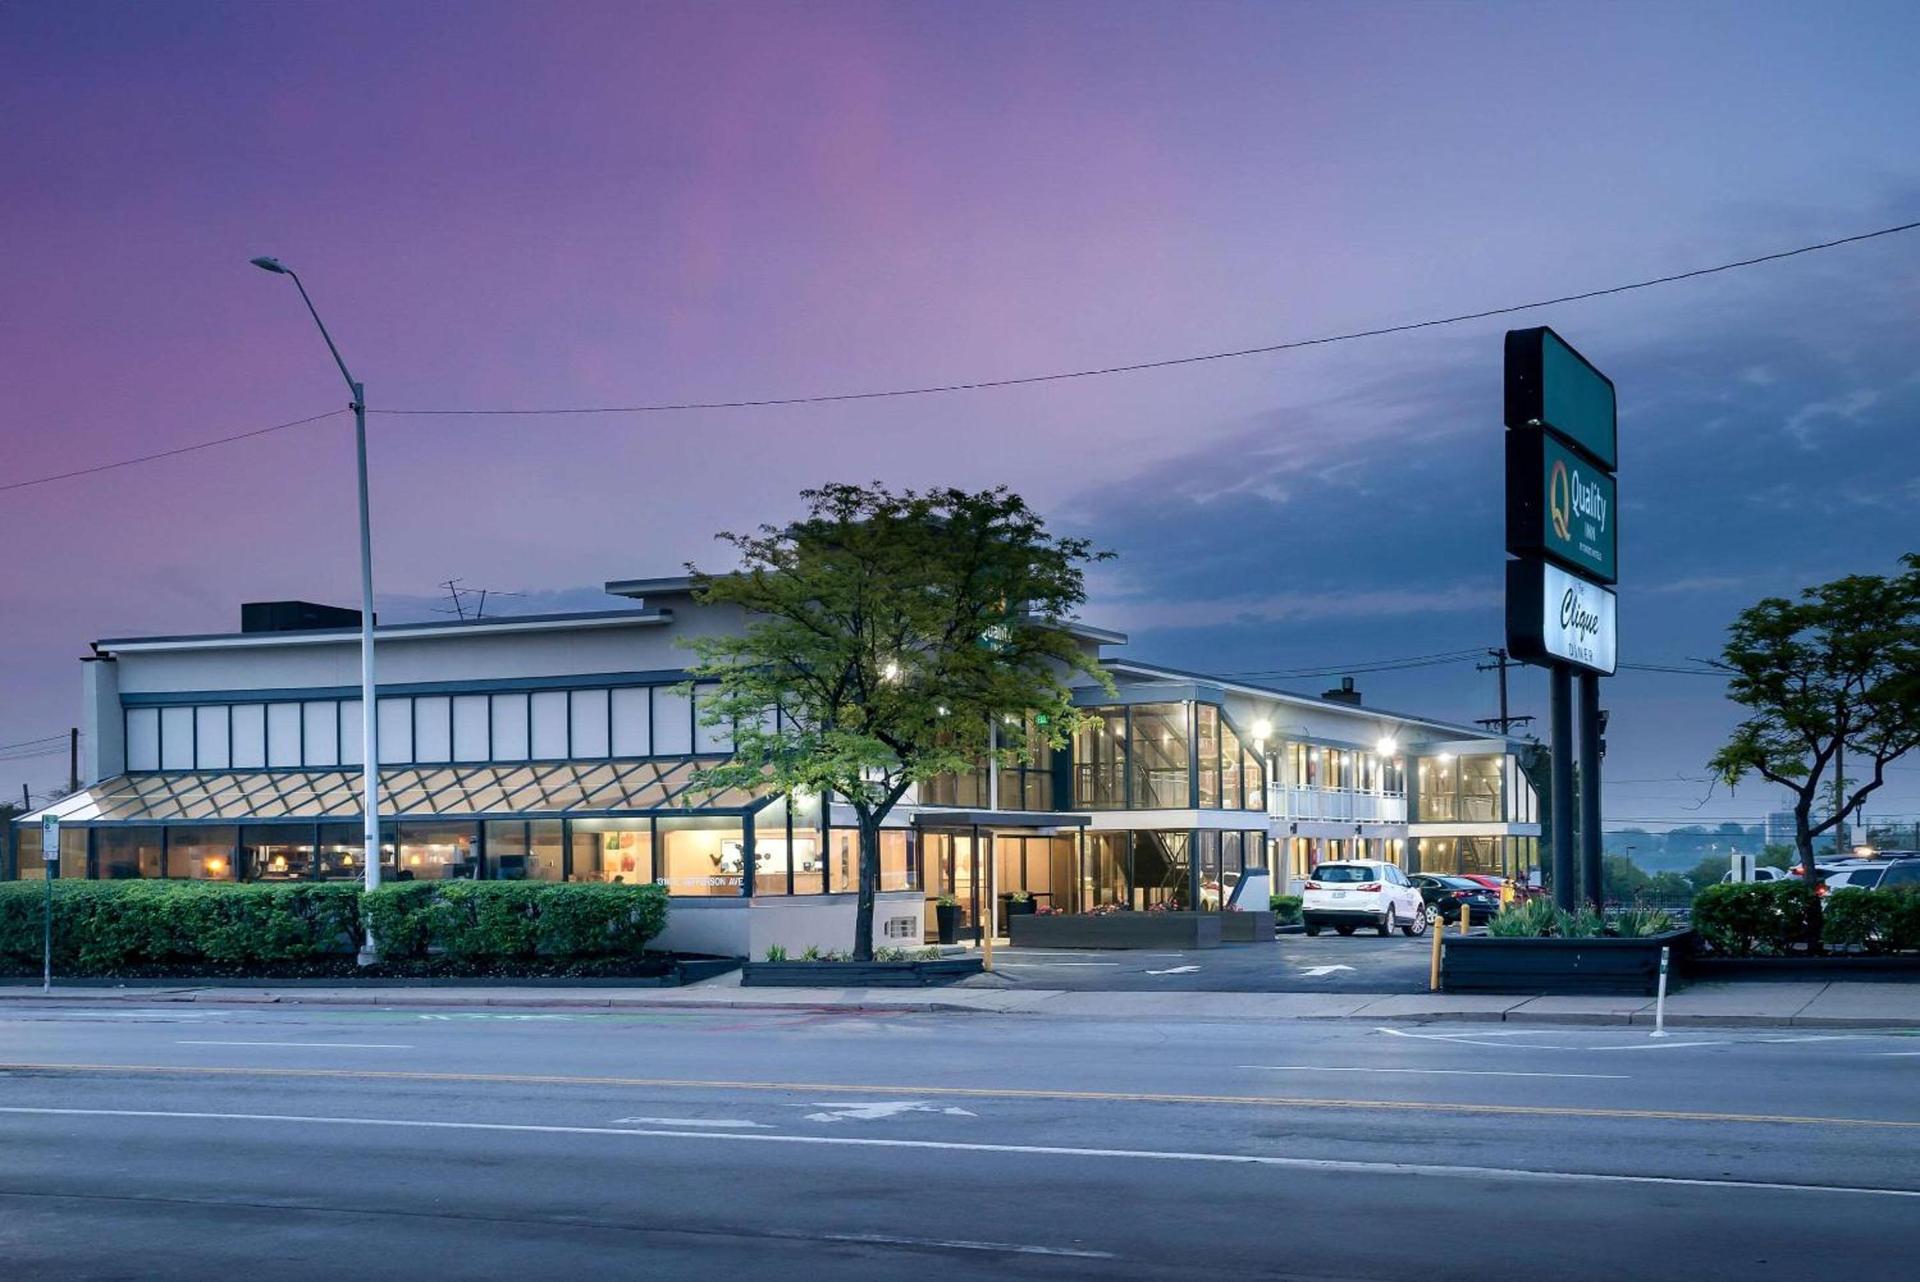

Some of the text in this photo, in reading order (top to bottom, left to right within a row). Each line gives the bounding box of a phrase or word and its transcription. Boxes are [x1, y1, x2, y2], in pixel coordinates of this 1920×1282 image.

[1571, 470, 1607, 533] Quality
[1560, 588, 1599, 643] Clique
[1568, 642, 1593, 662] DINER
